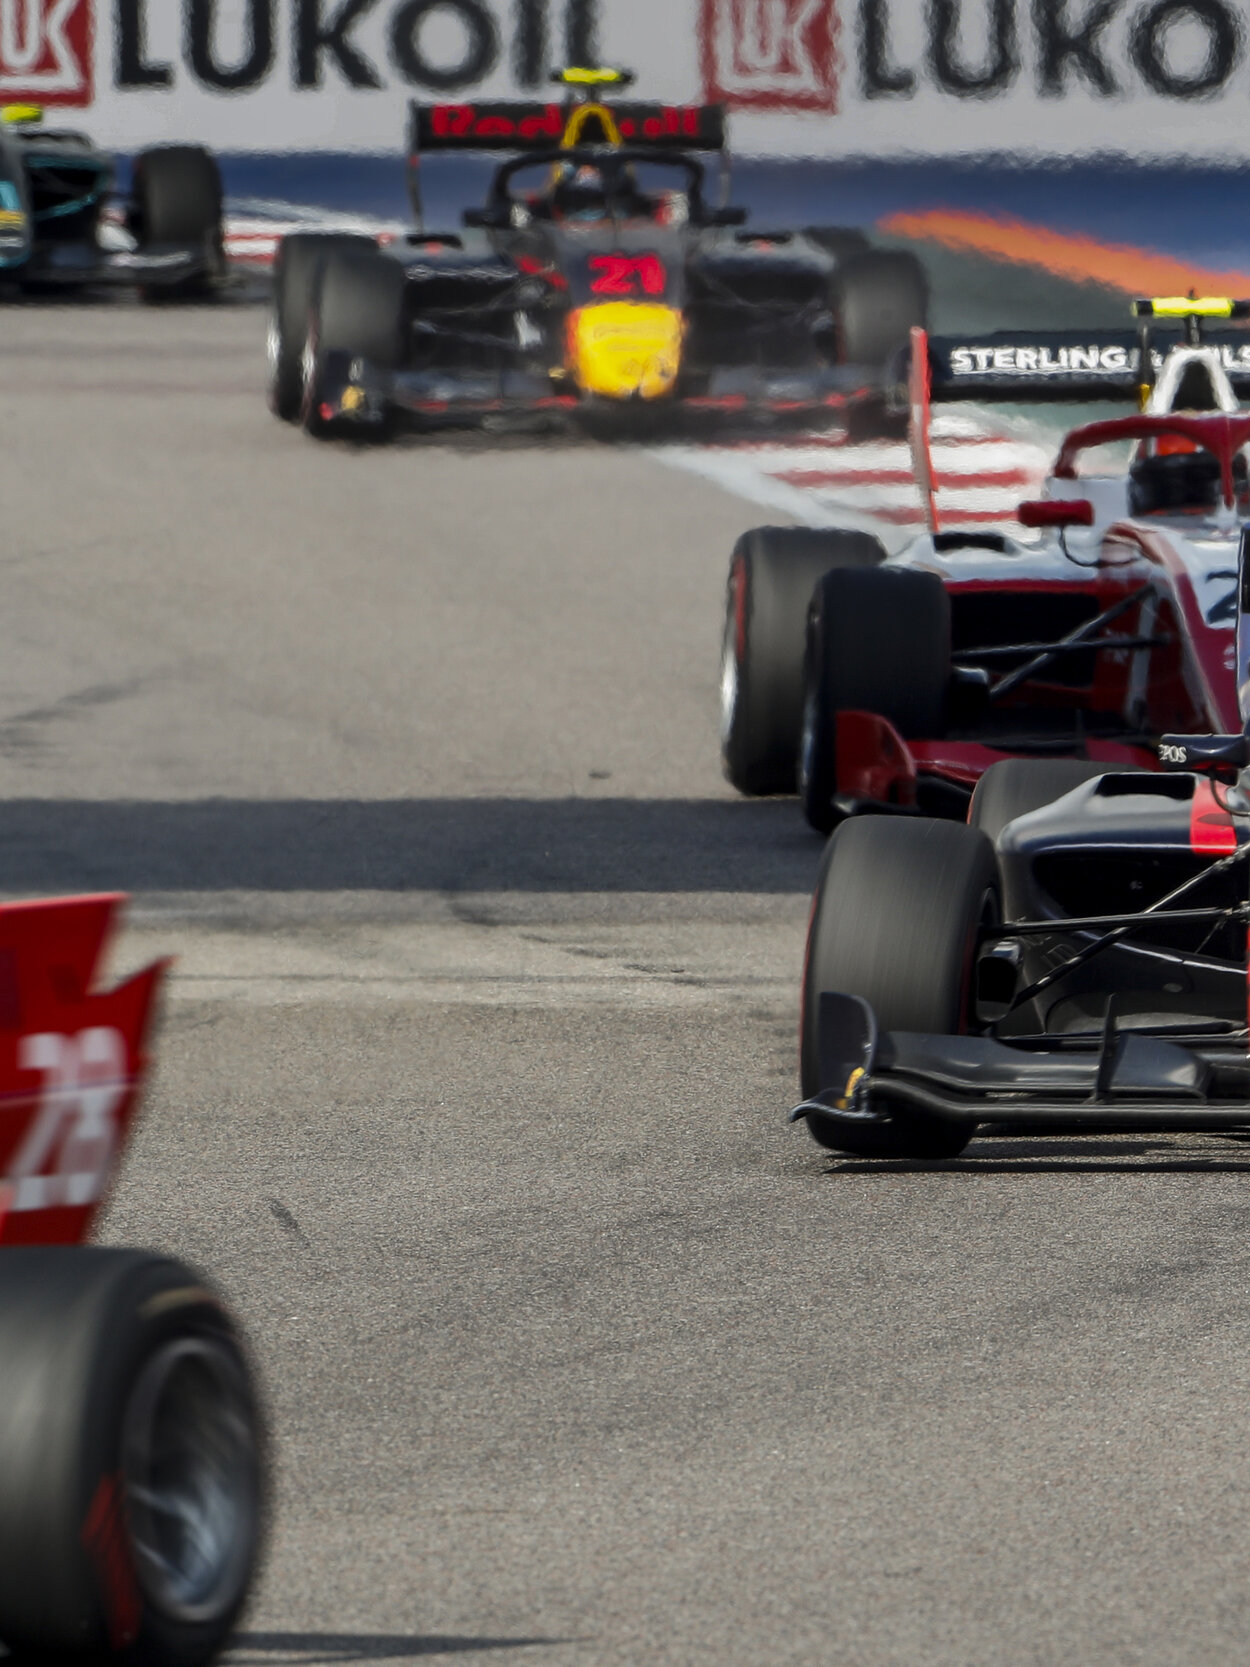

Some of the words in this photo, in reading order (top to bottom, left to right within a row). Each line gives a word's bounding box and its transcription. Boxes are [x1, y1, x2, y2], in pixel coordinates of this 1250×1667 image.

[113, 0, 625, 94] LUKOIL
[587, 252, 667, 295] 21
[951, 345, 1128, 373] STERLING
